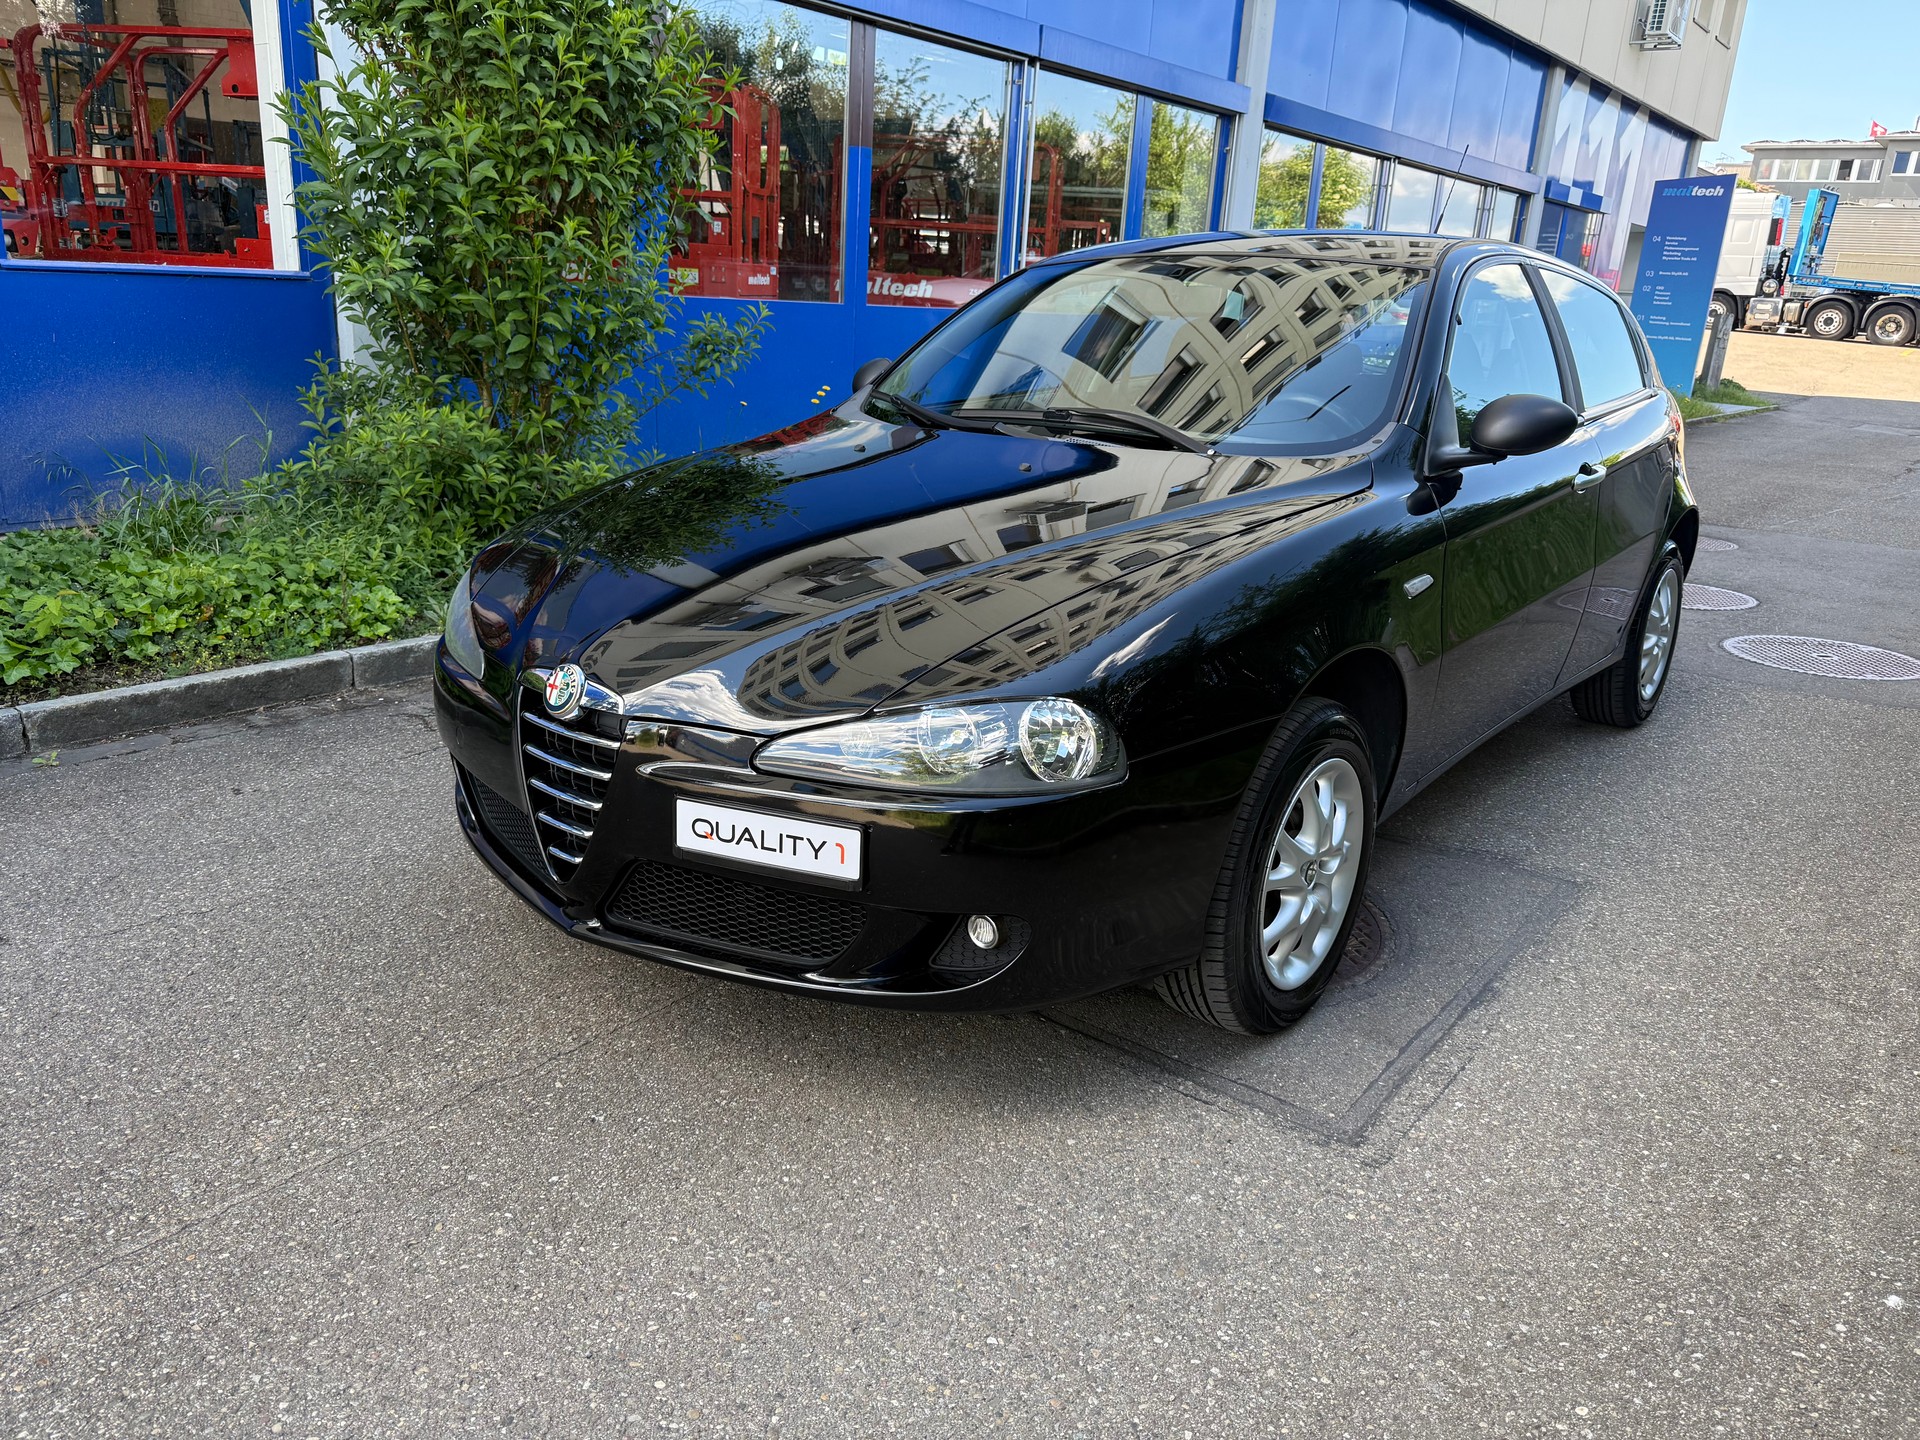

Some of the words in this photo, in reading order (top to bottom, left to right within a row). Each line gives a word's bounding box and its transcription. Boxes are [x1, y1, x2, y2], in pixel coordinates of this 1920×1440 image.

[1663, 186, 1724, 196] maltech
[692, 818, 828, 860] QUALITY
[836, 842, 844, 864] 1
